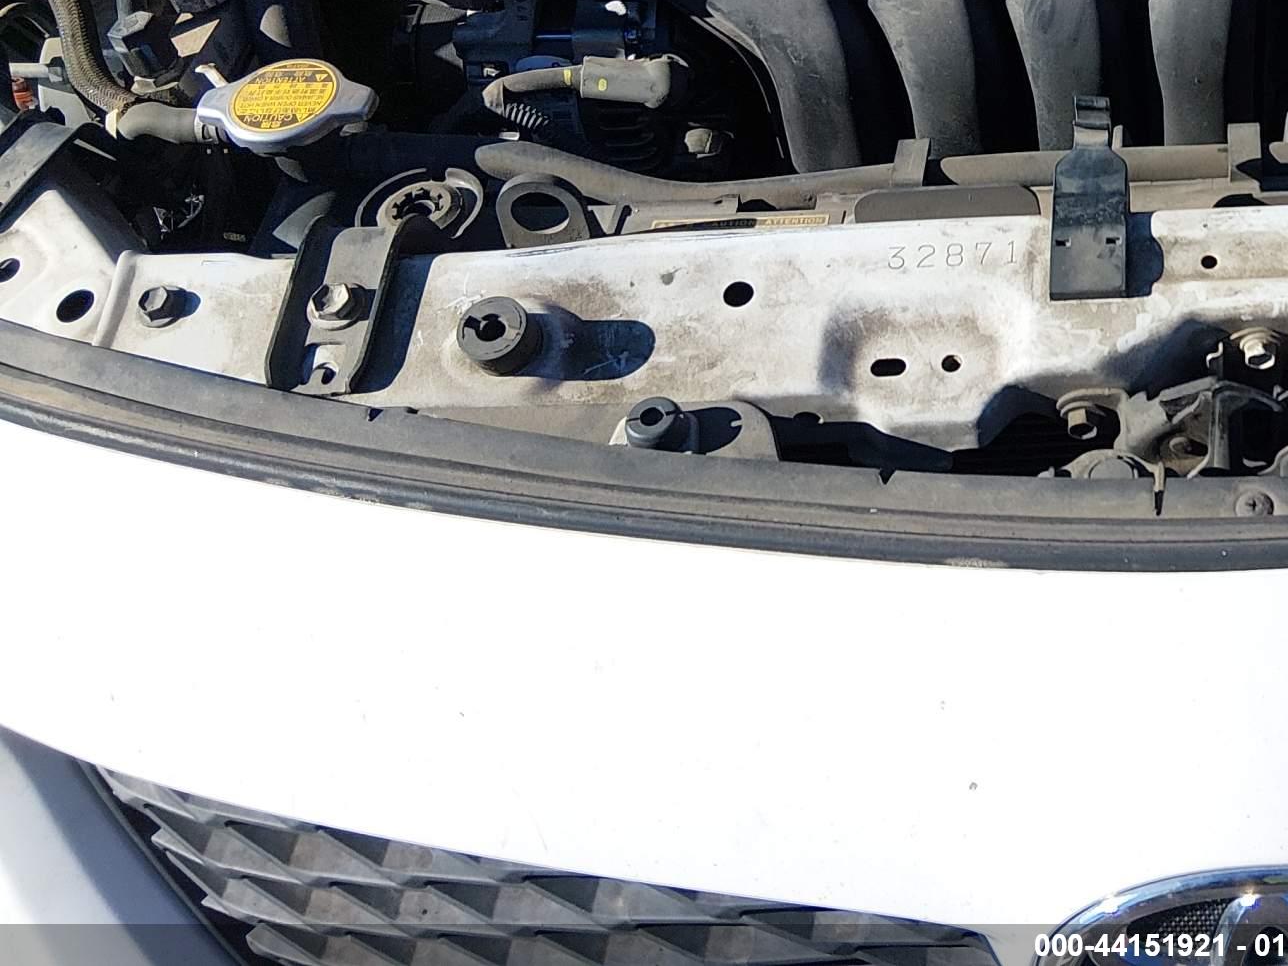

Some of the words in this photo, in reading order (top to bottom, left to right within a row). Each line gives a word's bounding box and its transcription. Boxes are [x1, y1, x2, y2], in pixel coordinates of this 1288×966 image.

[243, 114, 293, 123] CAUTION
[765, 217, 823, 226] ATTENTION
[887, 241, 1019, 270] 32871
